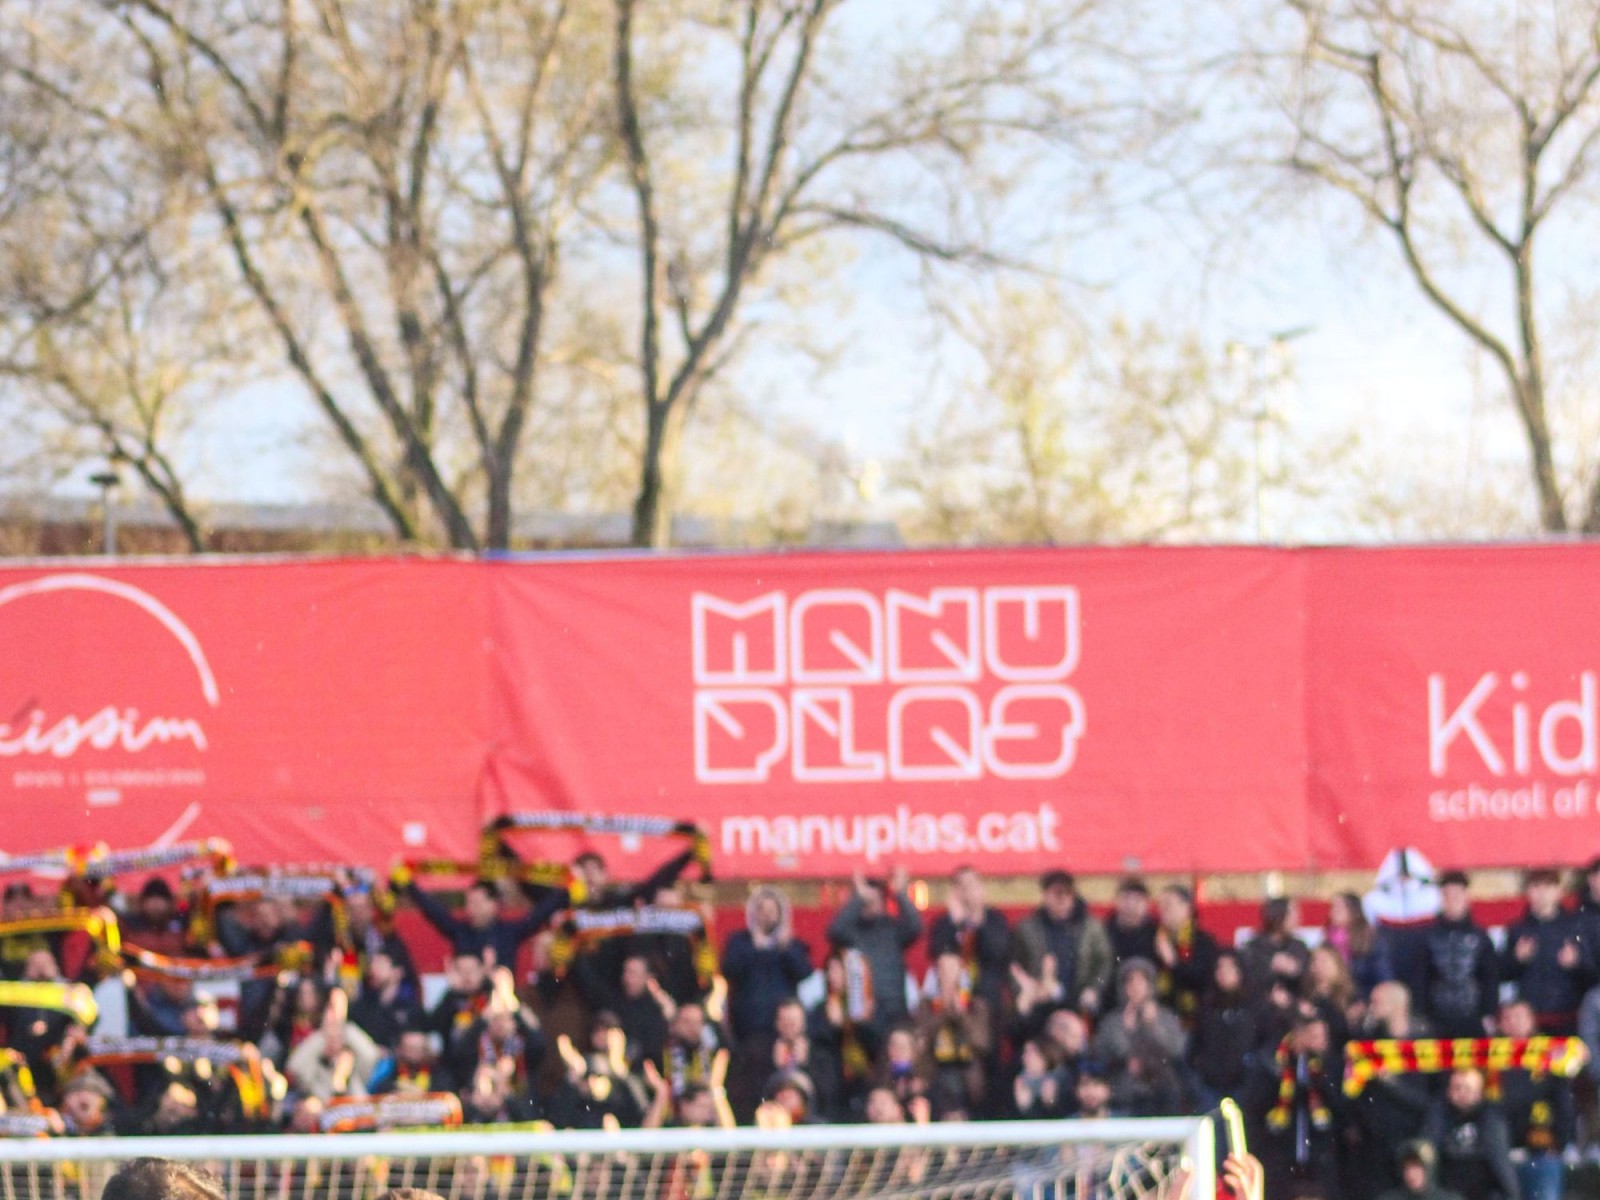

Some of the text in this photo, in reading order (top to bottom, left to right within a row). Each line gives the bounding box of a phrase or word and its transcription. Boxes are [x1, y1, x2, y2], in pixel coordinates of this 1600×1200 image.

[692, 586, 1081, 685] MANU
[694, 684, 1087, 783] PLAS
[1428, 671, 1599, 778] Kid
[721, 805, 1062, 862] manuplas.cat
[1428, 780, 1592, 822] school of
